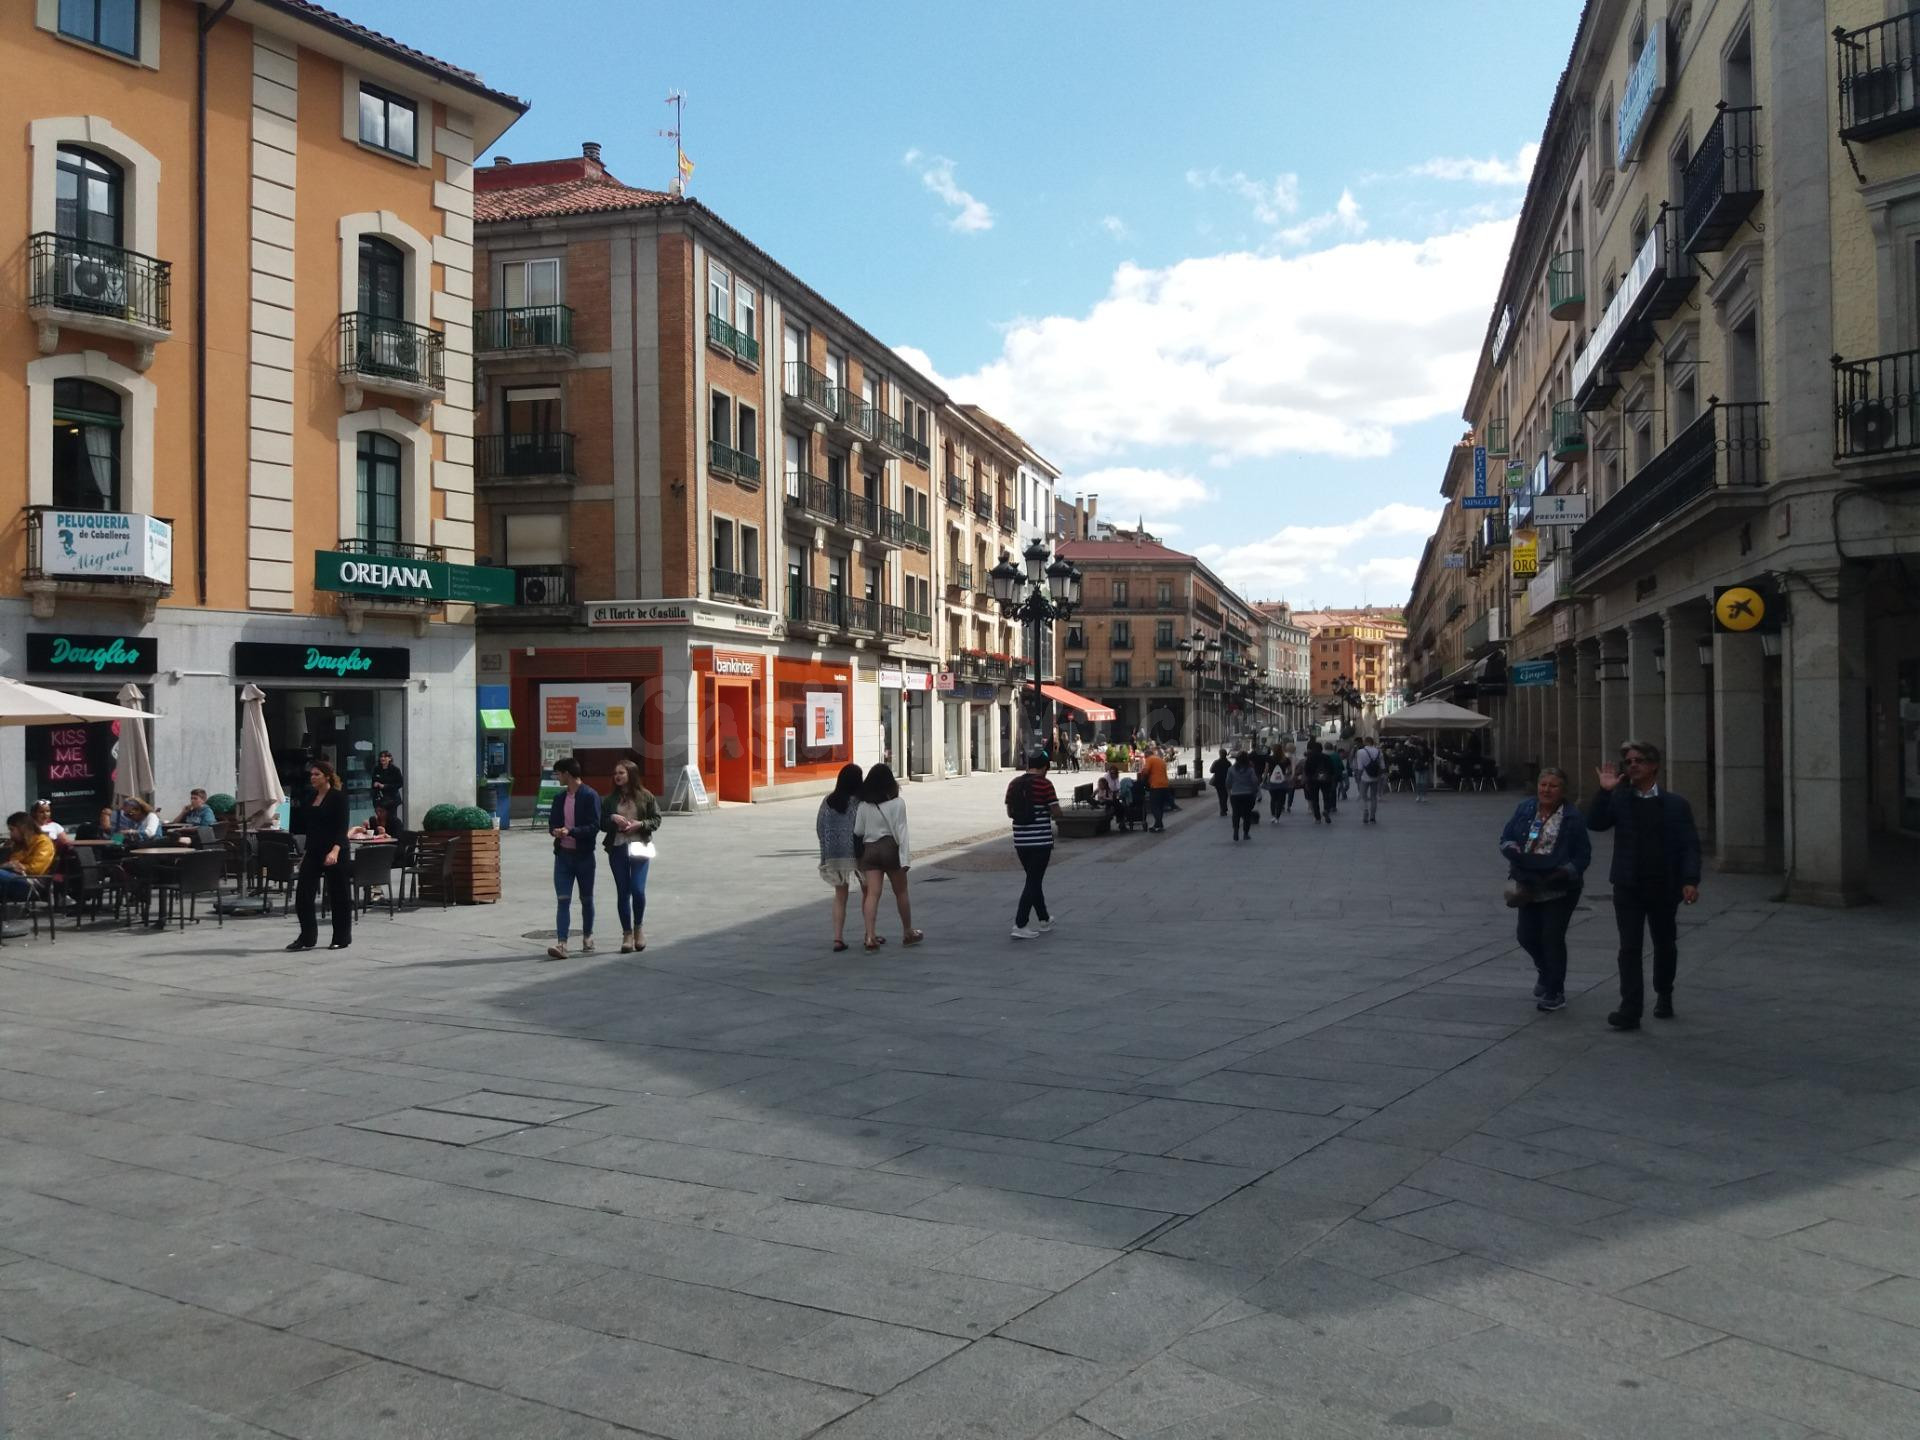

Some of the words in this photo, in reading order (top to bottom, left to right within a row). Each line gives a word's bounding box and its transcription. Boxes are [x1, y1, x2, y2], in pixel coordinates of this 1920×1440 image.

[58, 514, 129, 529] PELUQUERIA
[79, 530, 89, 539] de
[91, 530, 130, 540] Caballeros
[1513, 559, 1537, 571] ORO
[340, 561, 433, 589] OREJANA
[595, 607, 607, 620] El
[611, 607, 635, 619] Norte
[638, 607, 647, 619] de
[649, 606, 686, 619] Castilla
[50, 638, 140, 672] Douglas
[304, 647, 372, 677] Douglas
[716, 658, 754, 674] bankinter
[51, 729, 87, 746] KISS
[56, 746, 82, 761] ME
[50, 763, 96, 780] KARL
